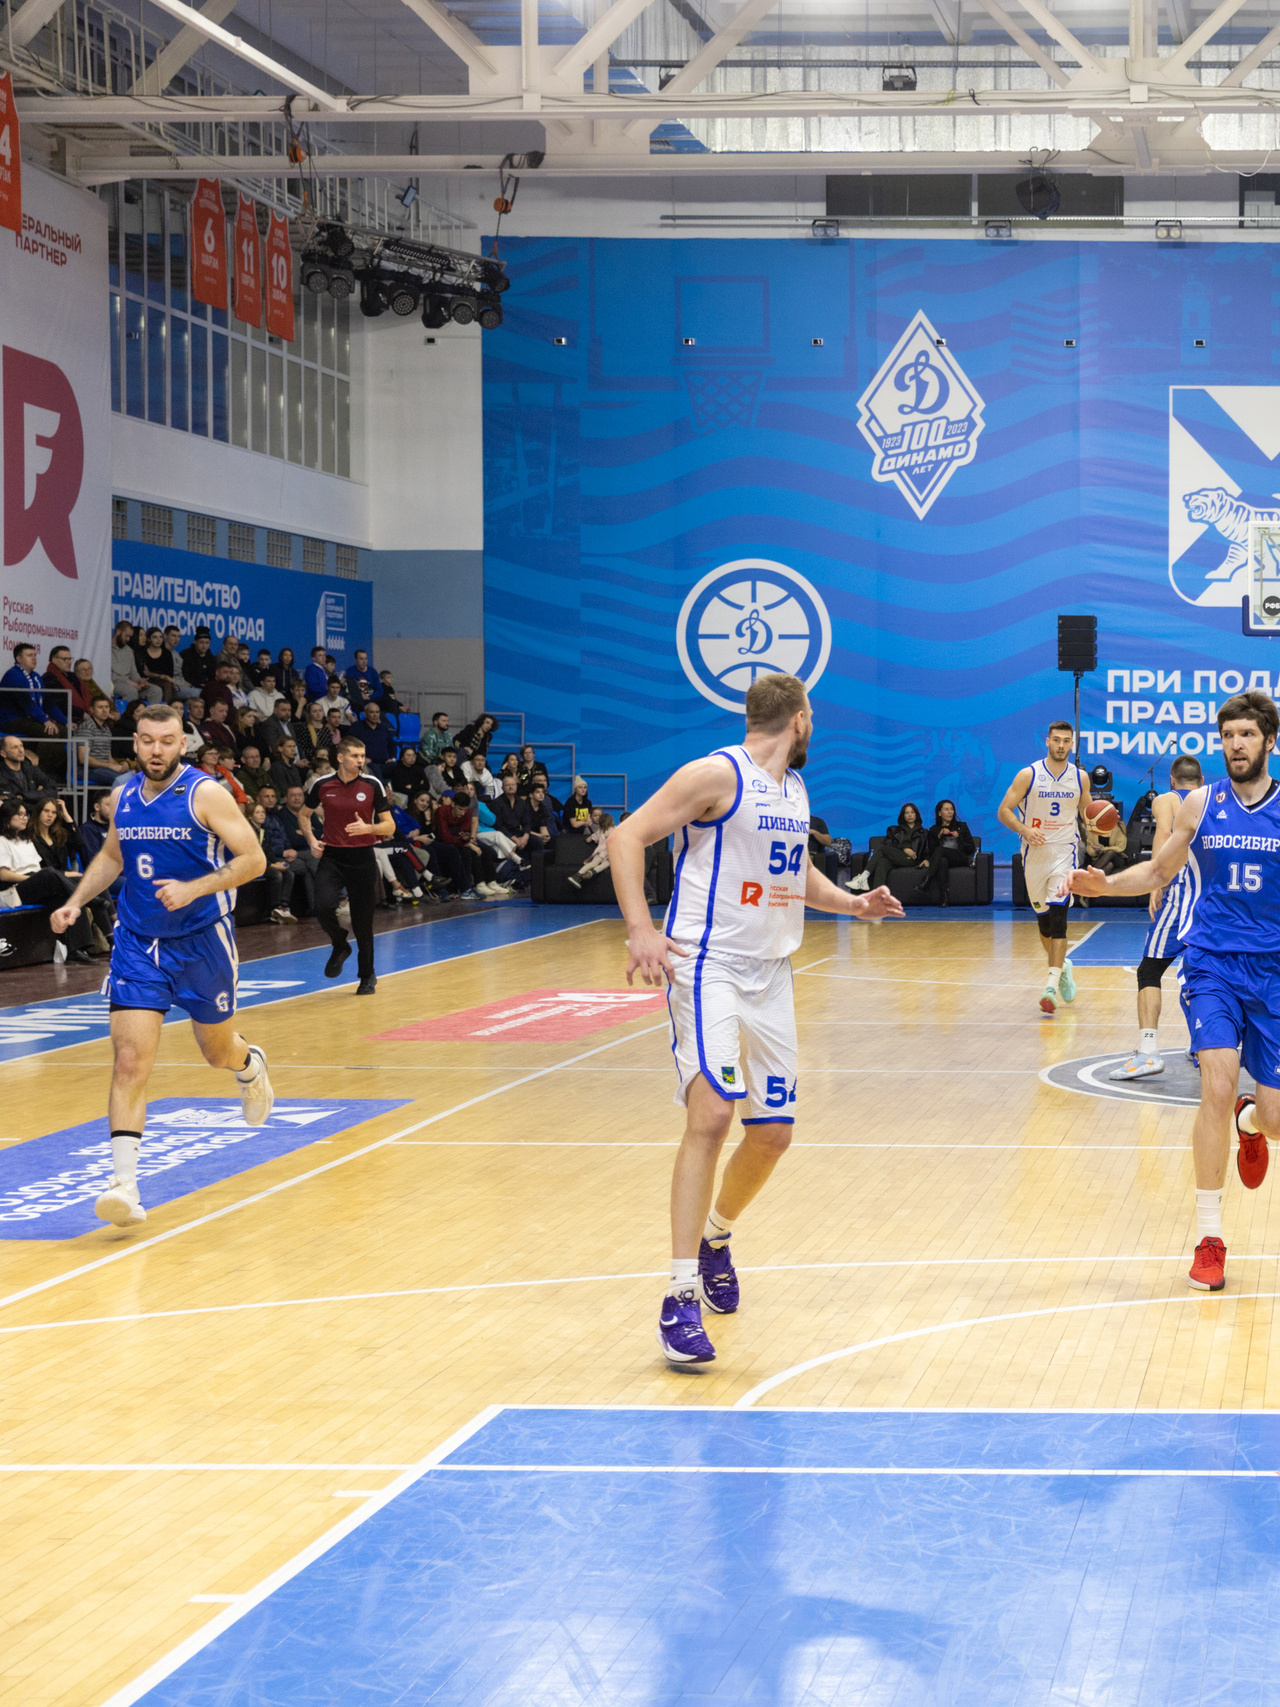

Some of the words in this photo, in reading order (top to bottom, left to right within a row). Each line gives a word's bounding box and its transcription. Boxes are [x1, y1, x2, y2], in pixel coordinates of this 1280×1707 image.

[22, 213, 82, 254] ЕРАЛЬНЫЙ
[204, 218, 215, 253] 6
[15, 233, 67, 267] ПАРТНЕР
[242, 237, 254, 274] 11
[271, 252, 287, 290] 10
[882, 436, 902, 449] 1923
[898, 418, 951, 453] 100
[947, 421, 969, 436] 2023
[881, 442, 968, 472] ДИНАМО
[912, 464, 935, 476] ЛЕТ
[111, 570, 241, 610] ПРАВИТЕЛЬСТВО
[3, 596, 34, 615] Русская
[3, 616, 79, 640] Рыбопромышленная
[229, 615, 265, 642] КРАЯ
[3, 635, 41, 655] Комия
[1107, 670, 1182, 694] ПРИ
[1038, 791, 1075, 799] ДИНАМО
[1050, 802, 1060, 816] 3
[117, 826, 192, 840] ВОСИБИРСК
[137, 853, 154, 880] 6
[768, 841, 804, 876] 54
[1228, 862, 1264, 892] 15
[0, 1131, 261, 1222] ПРАВИТЕЬСТВО
